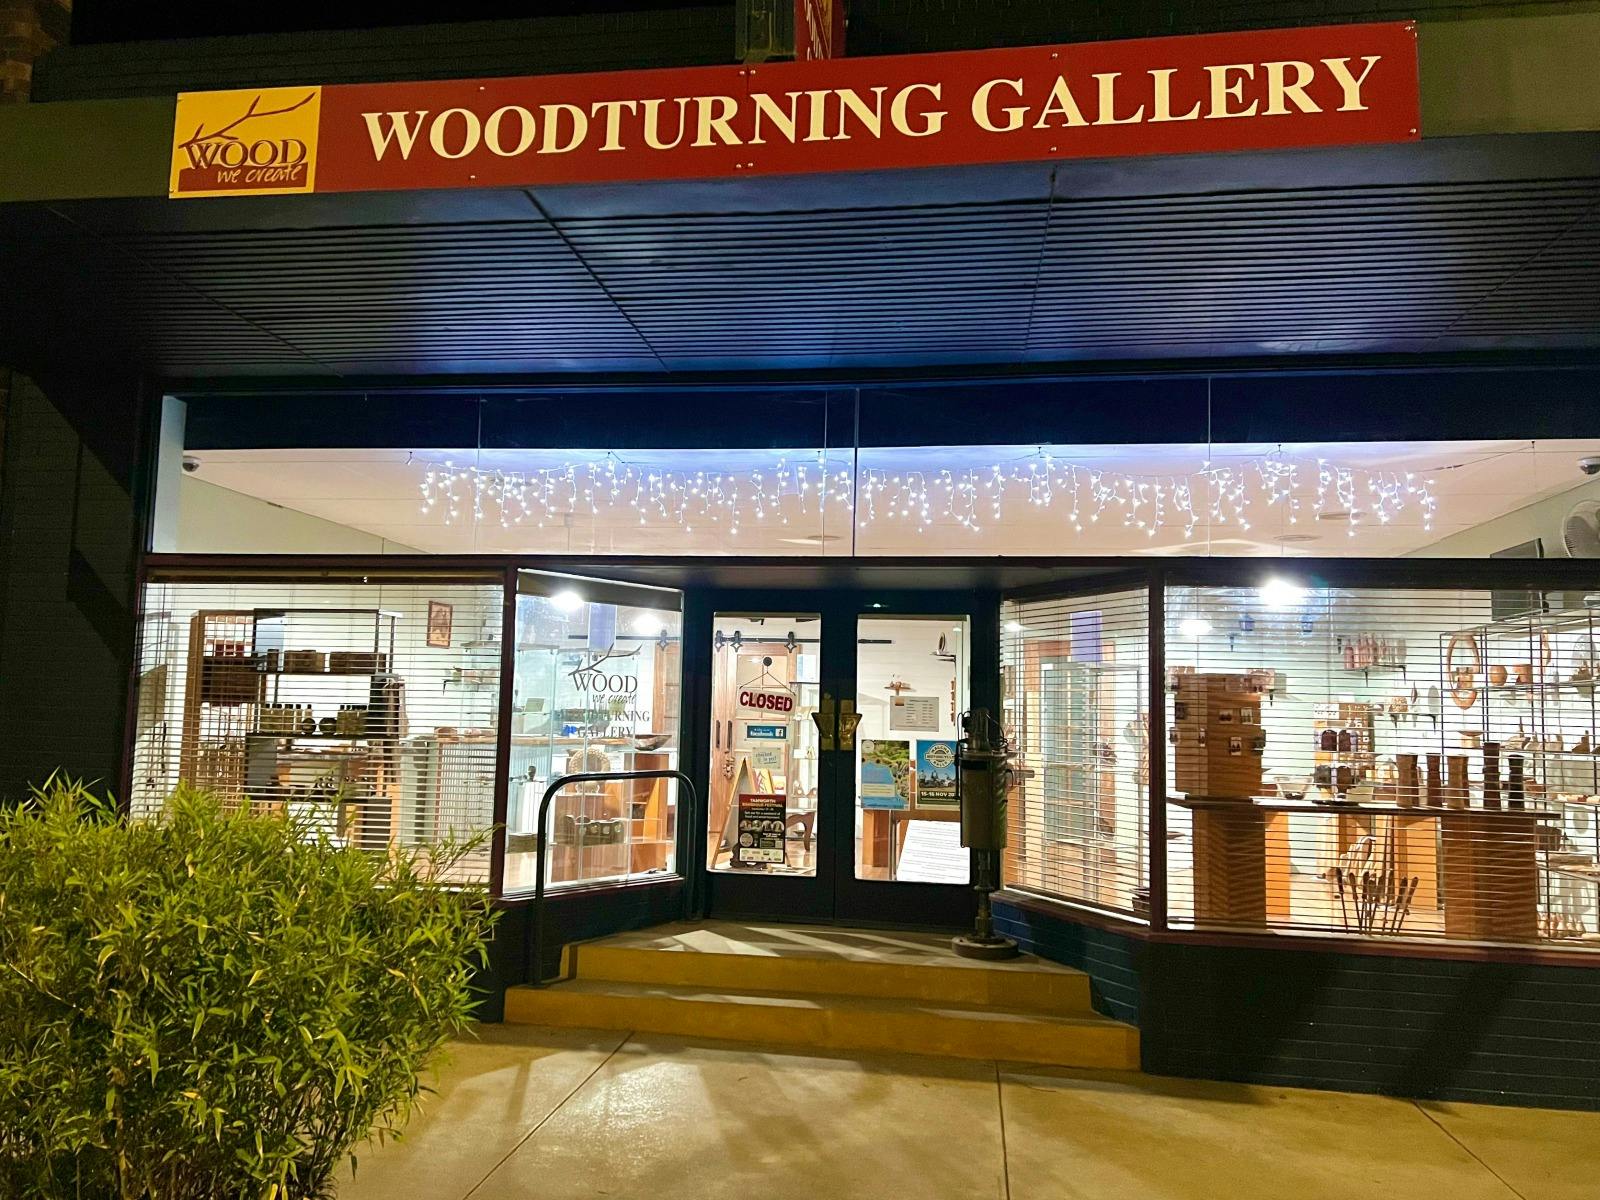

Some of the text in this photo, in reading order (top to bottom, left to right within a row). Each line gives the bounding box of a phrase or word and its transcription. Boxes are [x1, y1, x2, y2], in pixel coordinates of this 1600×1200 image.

[361, 55, 1382, 162] WOODTURNING GALLERY
[183, 138, 307, 170] WOOD
[216, 165, 302, 185] we create
[572, 673, 638, 693] WOOD
[592, 692, 638, 704] we create
[739, 691, 793, 712] CLOSED
[577, 725, 633, 739] GALLERY
